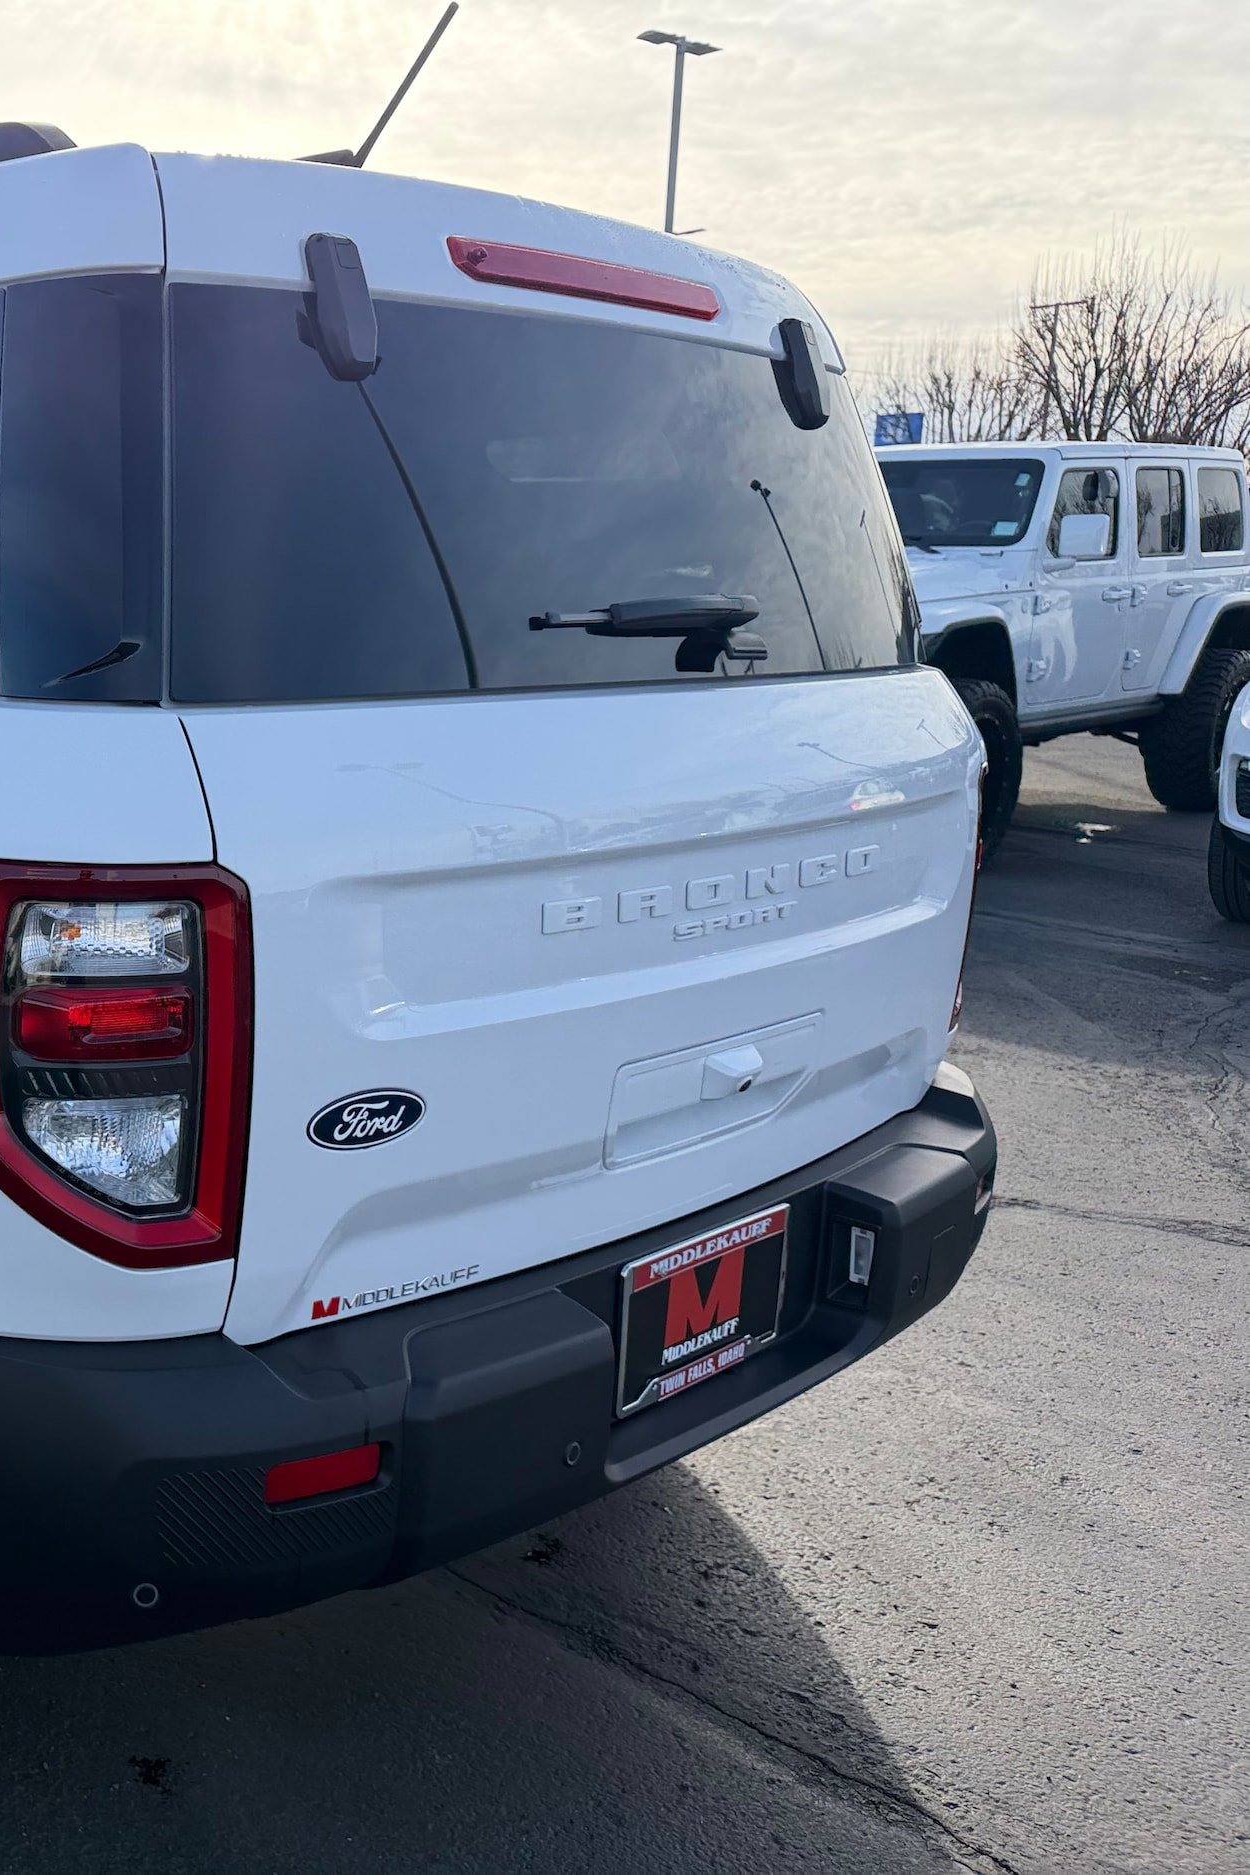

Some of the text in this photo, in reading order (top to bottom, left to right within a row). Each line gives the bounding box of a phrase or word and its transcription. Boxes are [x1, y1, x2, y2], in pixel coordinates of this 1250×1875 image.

[542, 844, 880, 935] BRONCO
[673, 901, 798, 941] SPORT
[333, 1100, 406, 1142] Ford
[650, 1217, 772, 1279] MIDDLEKAUFF
[341, 1264, 480, 1311] MIDDLEKAUFF
[661, 1317, 739, 1366] MIDDLEKAUFF
[659, 1373, 686, 1396] TWIN
[718, 1342, 746, 1368] IDAHO
